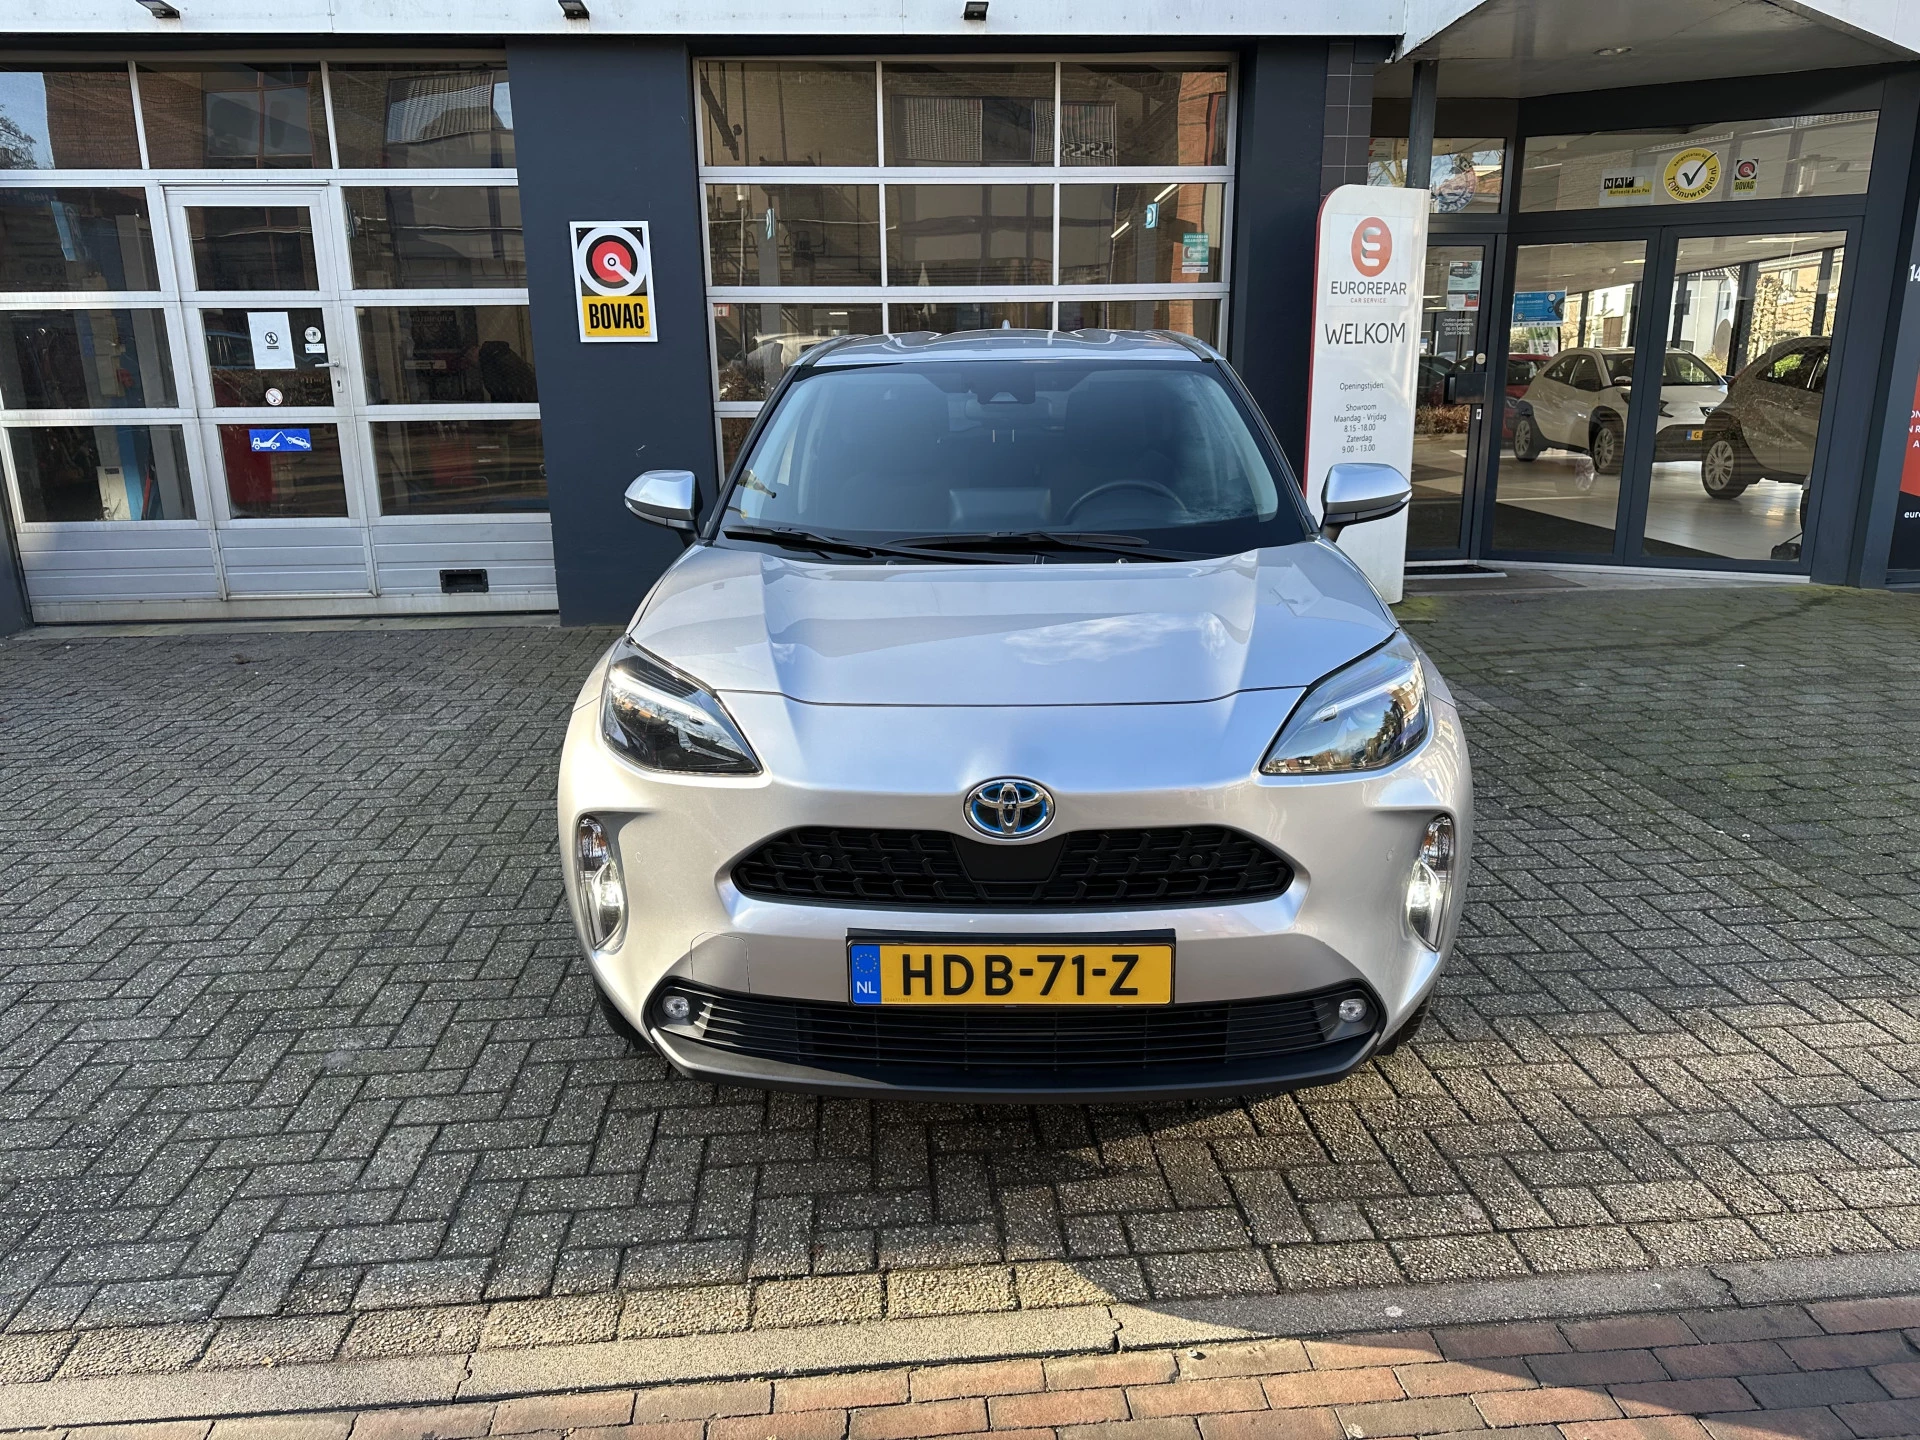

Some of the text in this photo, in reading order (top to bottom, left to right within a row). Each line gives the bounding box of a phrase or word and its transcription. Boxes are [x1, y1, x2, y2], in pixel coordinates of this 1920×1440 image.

[1605, 176, 1633, 188] NAP
[1734, 181, 1755, 191] BOVAG
[1330, 281, 1407, 295] EUROREPAR
[588, 302, 645, 330] BOVAG
[1325, 322, 1406, 345] WELKOM
[1345, 403, 1377, 411] Showroom
[1333, 414, 1361, 423] Maandag
[1367, 413, 1387, 422] Vrijdag
[1344, 424, 1357, 432] 8.15
[1346, 434, 1373, 443] Zaterdag
[1342, 445, 1355, 453] 9.00
[1360, 444, 1376, 452] 13.00
[902, 954, 1139, 996] HDB-71-Z
[856, 981, 877, 994] NL
